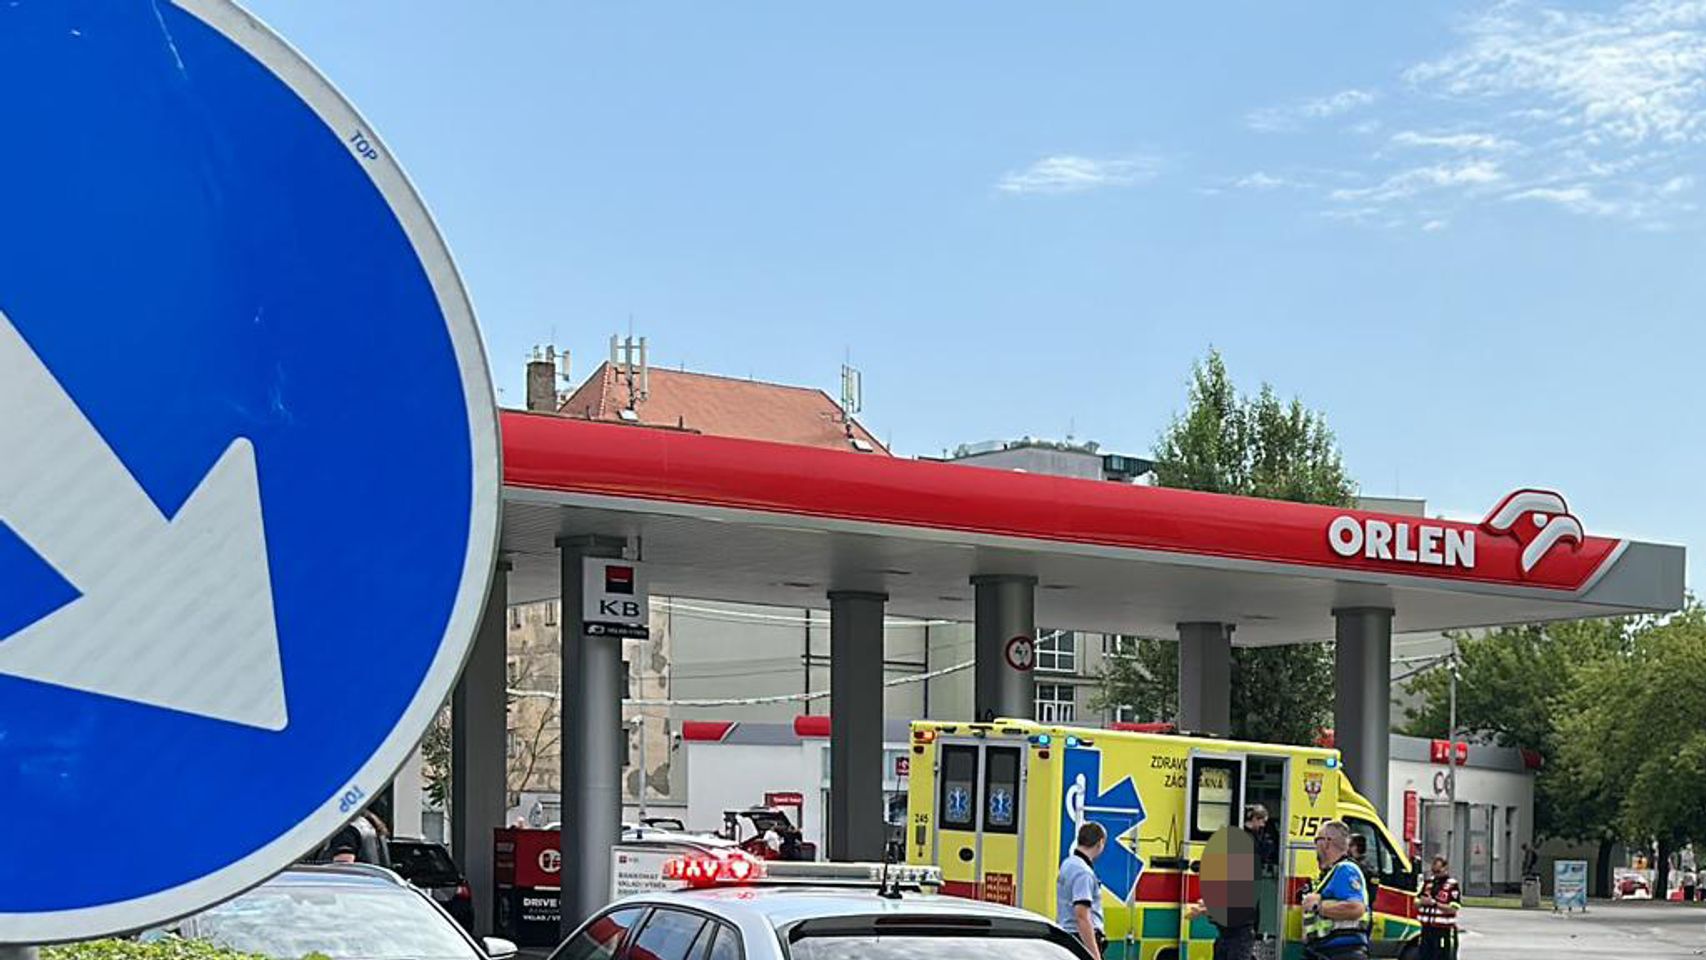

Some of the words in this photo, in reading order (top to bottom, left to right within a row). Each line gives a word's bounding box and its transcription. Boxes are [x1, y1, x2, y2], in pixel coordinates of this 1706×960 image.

[350, 129, 378, 160] TOP
[1328, 515, 1475, 568] ORLEN
[600, 599, 640, 617] KB
[339, 785, 365, 813] TOP
[523, 897, 558, 907] DRIVE
